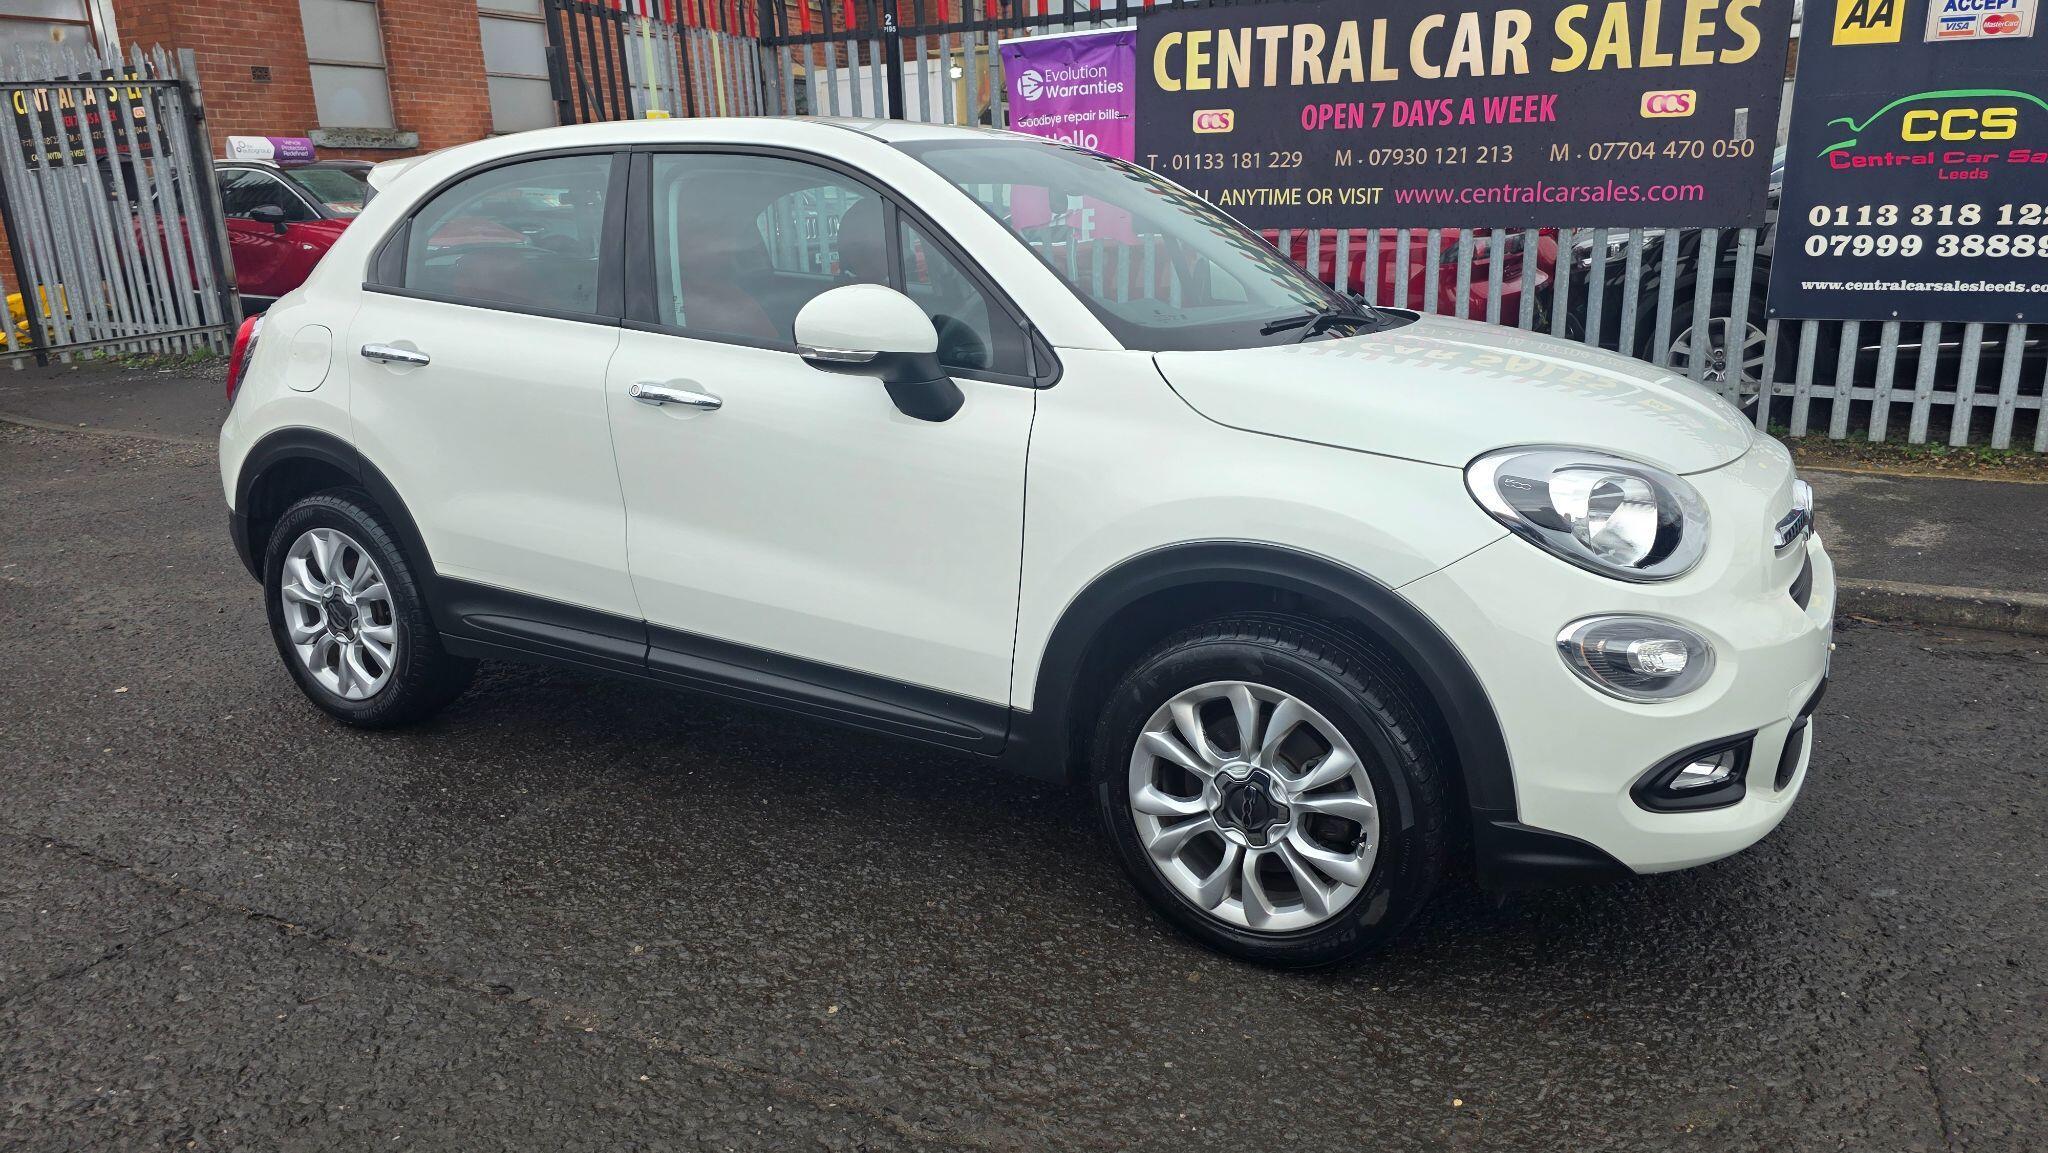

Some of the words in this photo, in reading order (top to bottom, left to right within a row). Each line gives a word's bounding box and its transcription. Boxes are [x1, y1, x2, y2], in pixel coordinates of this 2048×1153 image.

[884, 13, 893, 26] 2
[1841, 0, 1894, 29] AA
[1983, 20, 2020, 29] MasterCard
[1945, 22, 1970, 31] VISA
[1153, 18, 1399, 92] CENTRAL
[1409, 9, 1532, 80] CAR
[1550, 0, 1762, 72] SALES
[1045, 65, 1108, 83] Evolution
[1045, 80, 1124, 99] Warranties
[1301, 103, 1364, 131] OPEN
[1372, 102, 1387, 129] 7
[1392, 98, 1453, 127] DAYS
[1458, 97, 1476, 125] A
[1483, 94, 1558, 124] WEEK
[1646, 93, 1690, 114] CCS
[1018, 113, 1062, 128] Goodbye
[1063, 110, 1096, 125] repair
[1197, 112, 1230, 131] CCS
[1901, 107, 2018, 142] CCS
[1335, 150, 1352, 167] M
[1369, 148, 1427, 166] 07930
[1435, 147, 1467, 165] 121
[1476, 145, 1513, 163] 213
[1550, 144, 1569, 161] M
[1588, 142, 1655, 161] 07704
[1663, 140, 1705, 159] 470
[1712, 138, 1754, 157] 050
[1147, 154, 1159, 171] T
[1172, 153, 1224, 171] 01133
[1232, 152, 1261, 169] 181
[1268, 151, 1303, 168] 229
[1829, 151, 1934, 170] Central
[1943, 151, 1999, 165] Car
[1938, 168, 1990, 181] Leeds
[1219, 188, 1301, 206] ANYTIME
[1307, 187, 1333, 205] OR
[1338, 187, 1384, 204] VISIT
[1394, 180, 1705, 204] www.centralcarsales.com
[1808, 205, 1899, 226] 0113
[1911, 203, 1982, 226] 318
[1996, 203, 2048, 226] 12
[1804, 235, 1923, 257] 07999
[1801, 279, 2048, 293] www.centralcarsalesleeds.co
